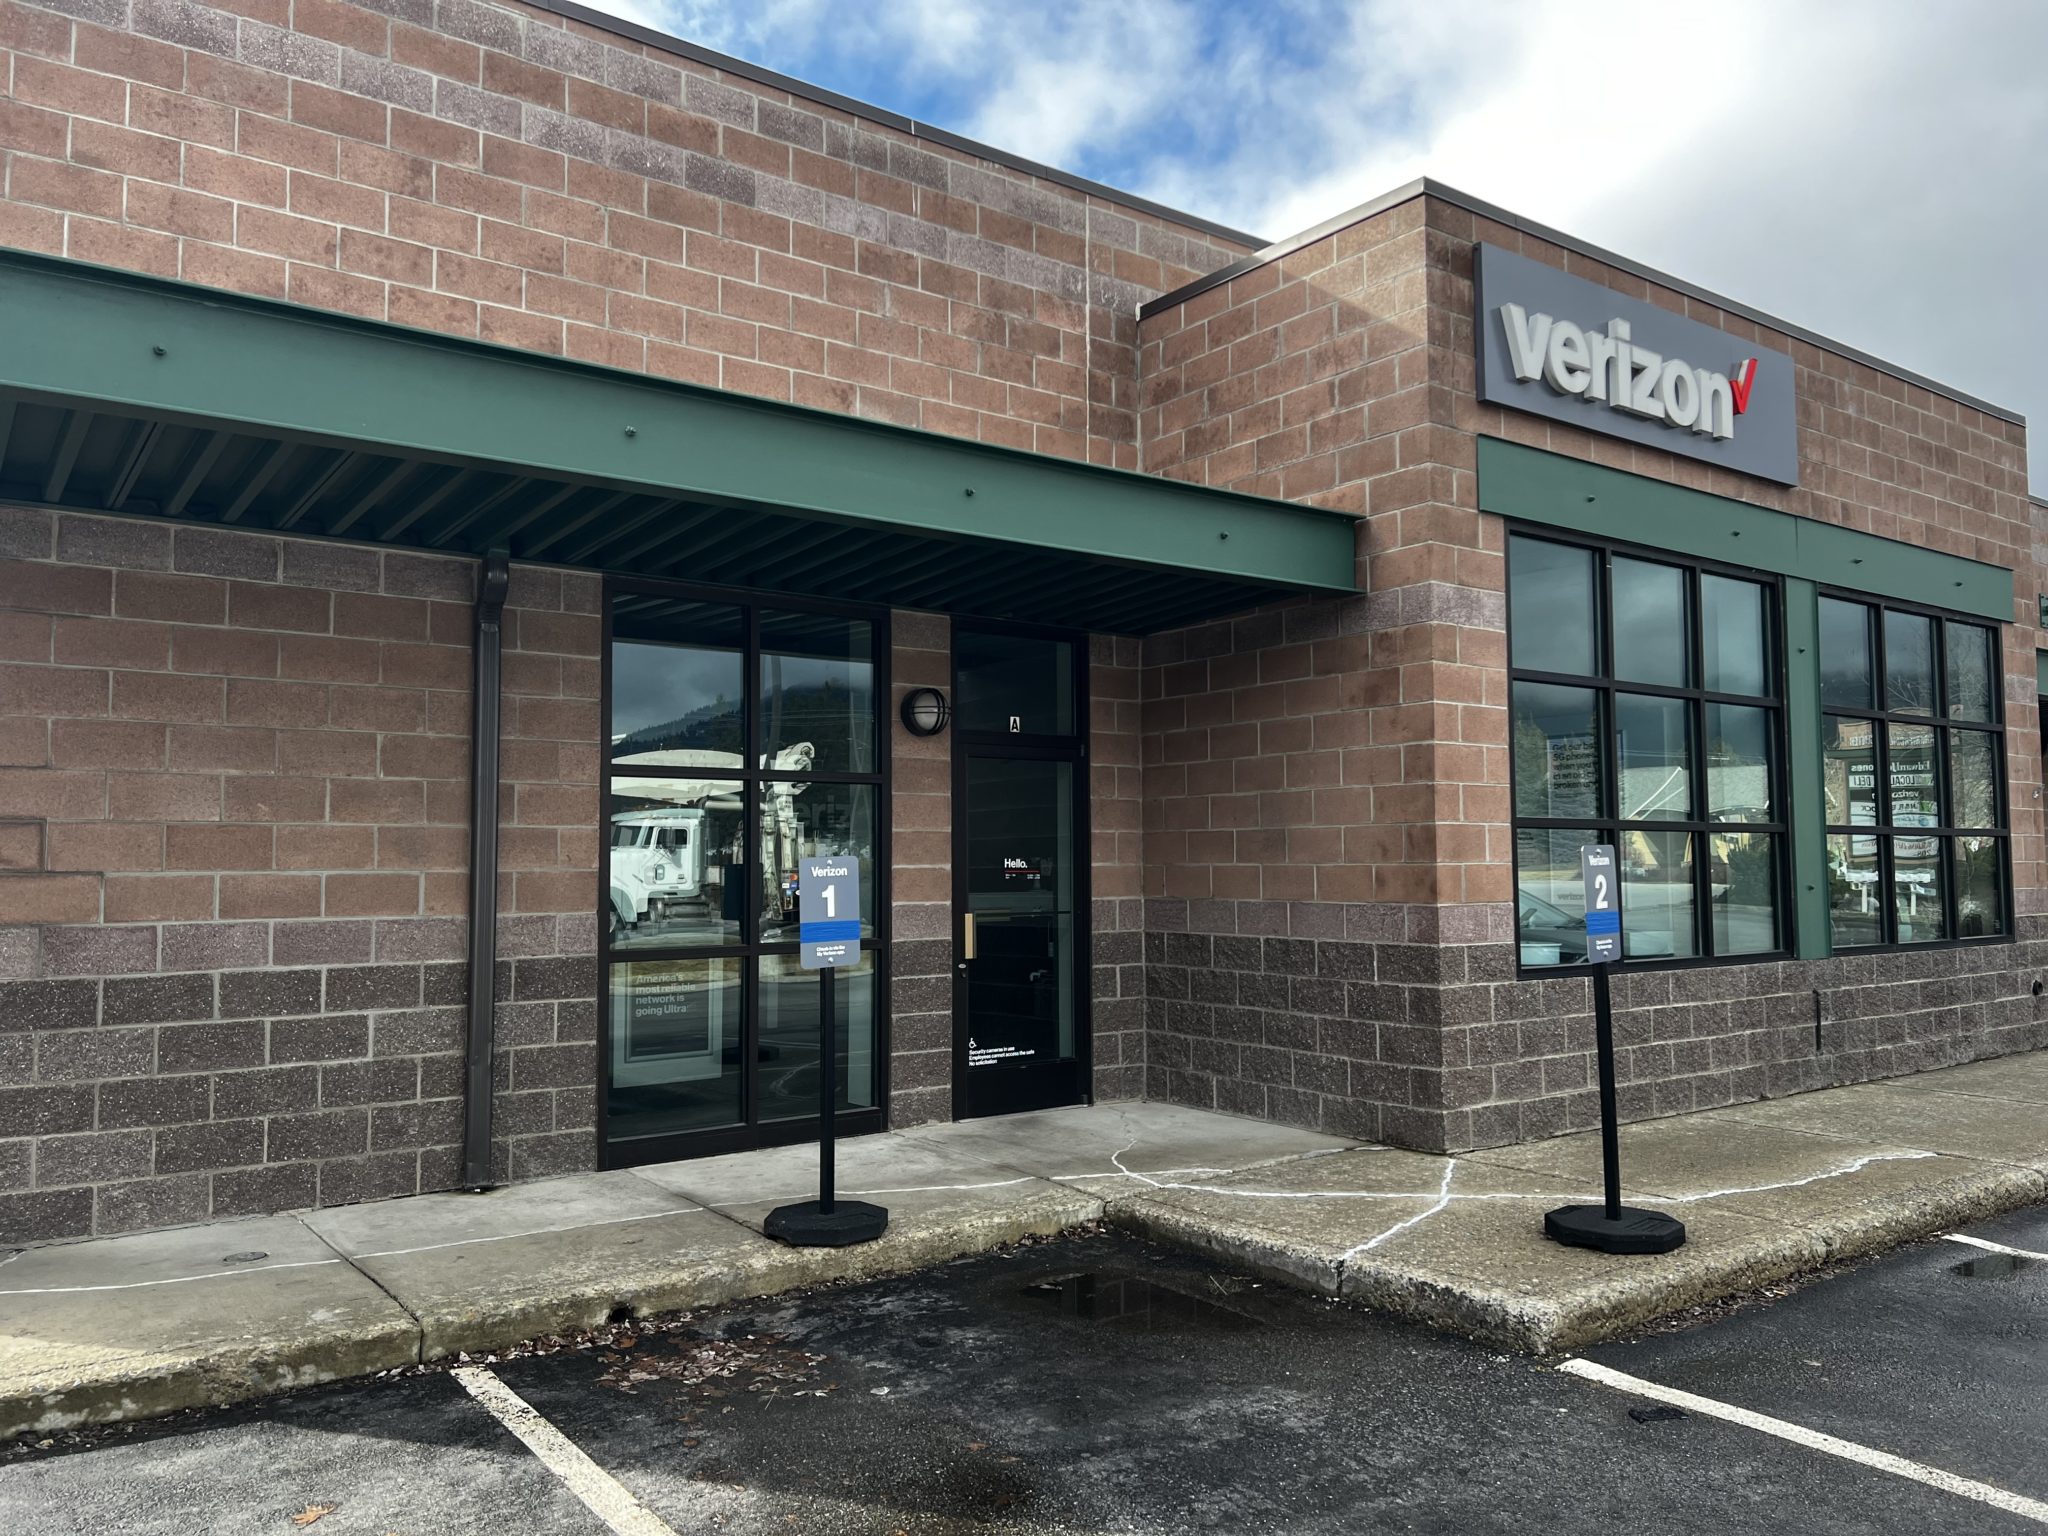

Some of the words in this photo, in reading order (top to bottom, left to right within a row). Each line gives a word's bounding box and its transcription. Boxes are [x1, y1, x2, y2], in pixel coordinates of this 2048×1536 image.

[1500, 302, 1734, 439] verizon
[1010, 717, 1019, 731] A
[1004, 858, 1028, 869] Hello.
[1588, 855, 1610, 866] Verizon
[811, 866, 847, 877] Verizon
[1594, 874, 1608, 909] 2
[821, 884, 835, 917] 1
[636, 973, 683, 984] America's
[636, 985, 660, 995] most
[661, 982, 696, 993] reliable
[636, 994, 675, 1005] network
[676, 993, 685, 1002] is
[635, 1006, 663, 1018] going
[664, 1004, 687, 1014] Ultra
